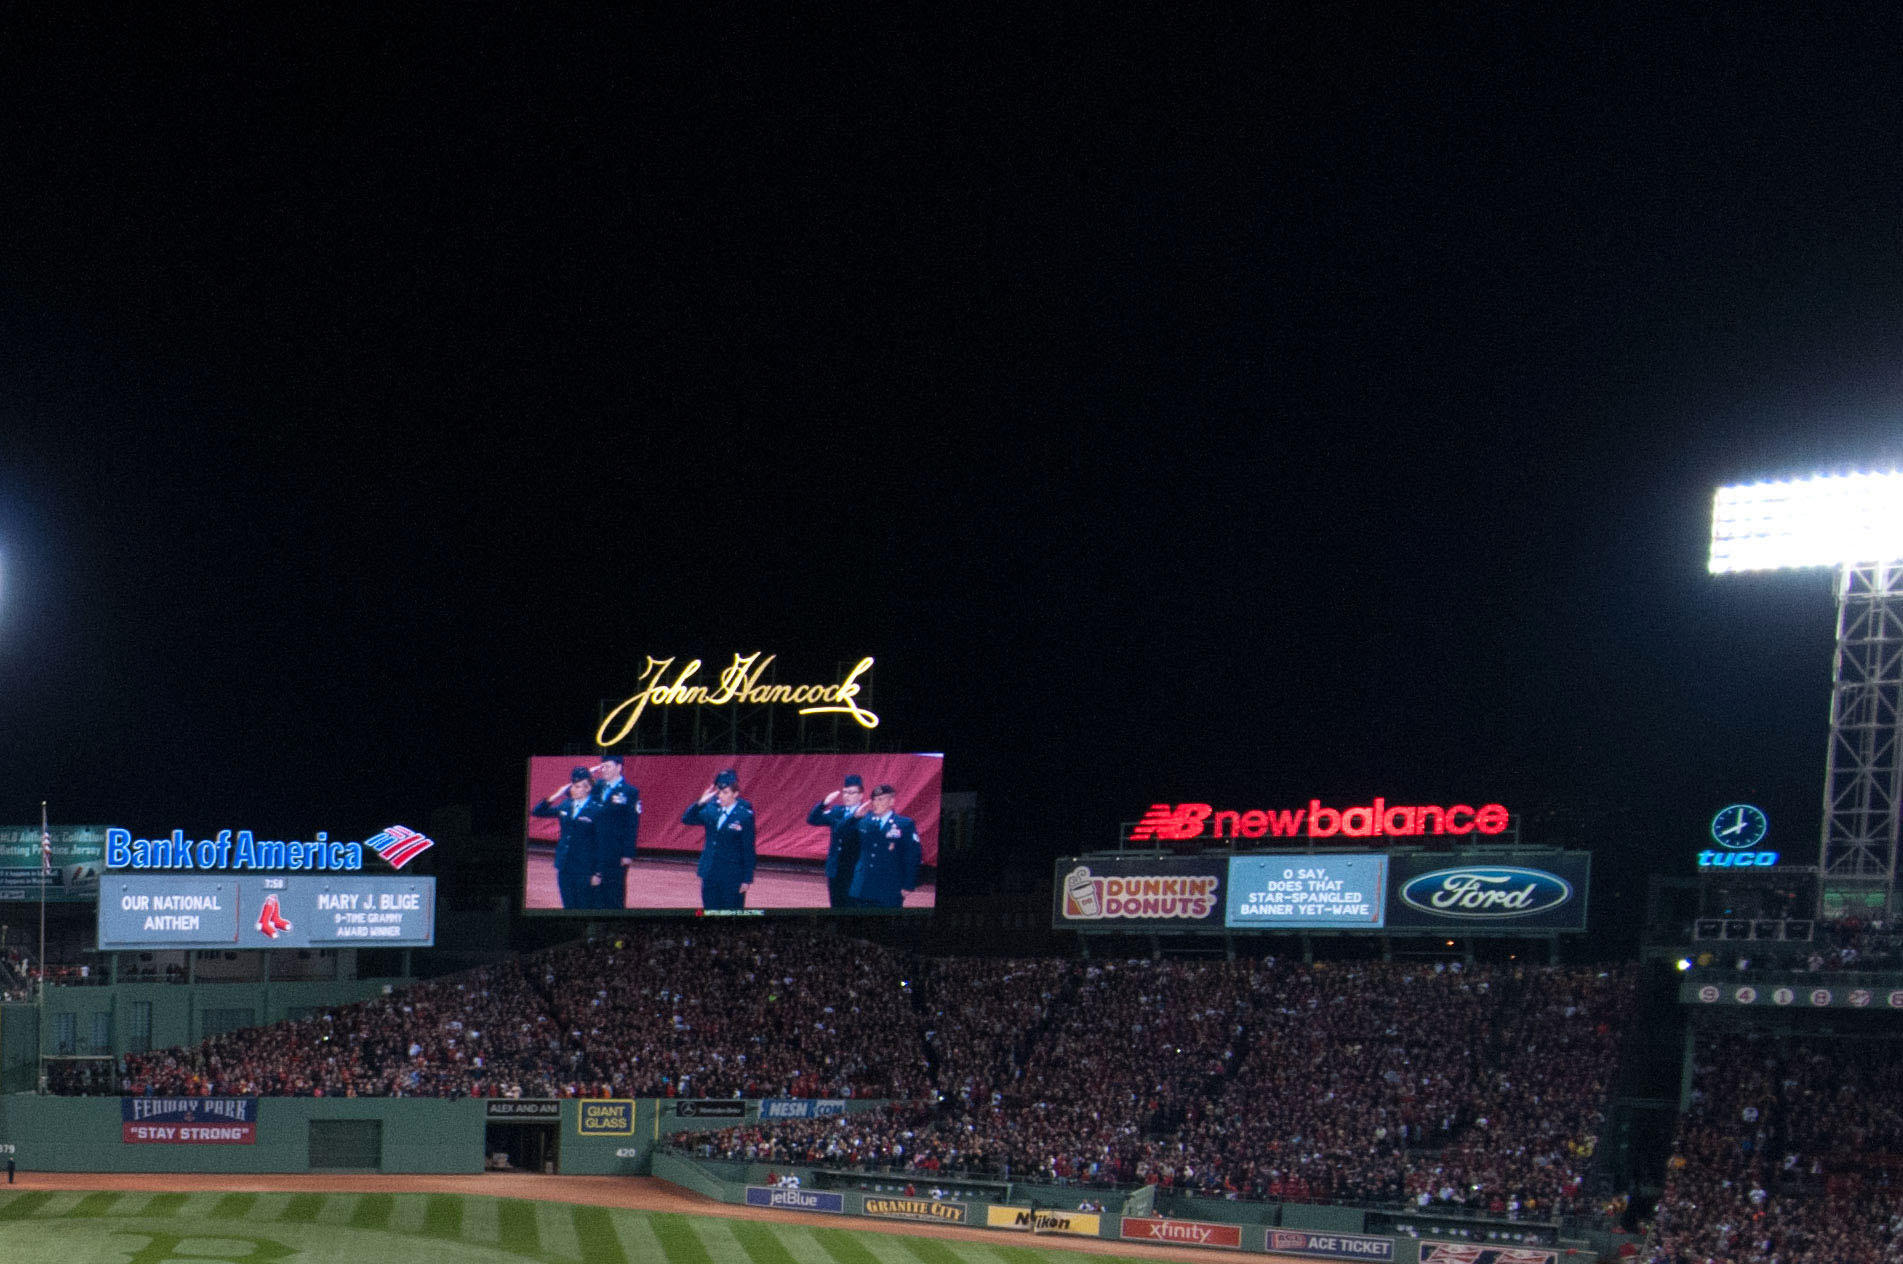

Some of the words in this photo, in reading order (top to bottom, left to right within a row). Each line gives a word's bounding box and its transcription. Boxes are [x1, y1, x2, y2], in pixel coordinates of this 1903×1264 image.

[596, 655, 709, 747] John
[706, 651, 879, 728] Hancock
[1214, 809, 1306, 838] new
[1308, 797, 1510, 837] balance
[32, 844, 69, 856] Prtice
[105, 828, 195, 869] Bank
[198, 829, 231, 869] of
[233, 830, 363, 870] America
[1283, 869, 1293, 880] O
[1297, 869, 1330, 882] SAY,
[1106, 878, 1215, 897] DUNKIN'
[1268, 881, 1304, 892] DOES
[1308, 881, 1344, 892] THAT
[1432, 874, 1538, 909] Ford
[121, 896, 149, 911] OUR
[153, 896, 222, 911] NATIONAL
[318, 894, 359, 910] MARY
[363, 894, 376, 910] J.
[380, 894, 421, 910] BLIGE
[1248, 892, 1363, 904] STAR-SPANGLED
[1106, 898, 1208, 915] DONUTS
[1240, 904, 1293, 915] BANNER
[1299, 904, 1370, 915] YET-WAVE
[144, 915, 200, 931] ANTHEM
[334, 914, 365, 924] 9-TIME
[367, 914, 403, 924] GRAMMY
[336, 926, 367, 937] AWARD
[370, 926, 401, 938] WINNER
[133, 1099, 198, 1121] FENWAY
[204, 1099, 247, 1121] PARK
[490, 1104, 514, 1113] ALEX
[516, 1104, 538, 1113] AND
[540, 1104, 558, 1113] ANI
[587, 1106, 626, 1116] GIANT
[769, 1101, 808, 1116] NESN
[585, 1118, 627, 1128] GLASS
[131, 1127, 175, 1139] "STAY
[180, 1127, 249, 1140] STRONG"
[616, 1148, 636, 1158] 420
[770, 1189, 818, 1207] jetBlue
[866, 1199, 929, 1215] GRANITE
[931, 1202, 964, 1221] CITY
[1015, 1211, 1071, 1230] Nikon
[1149, 1221, 1211, 1244] xfinity
[1309, 1237, 1337, 1250] ACE
[1339, 1238, 1390, 1255] TICKET
